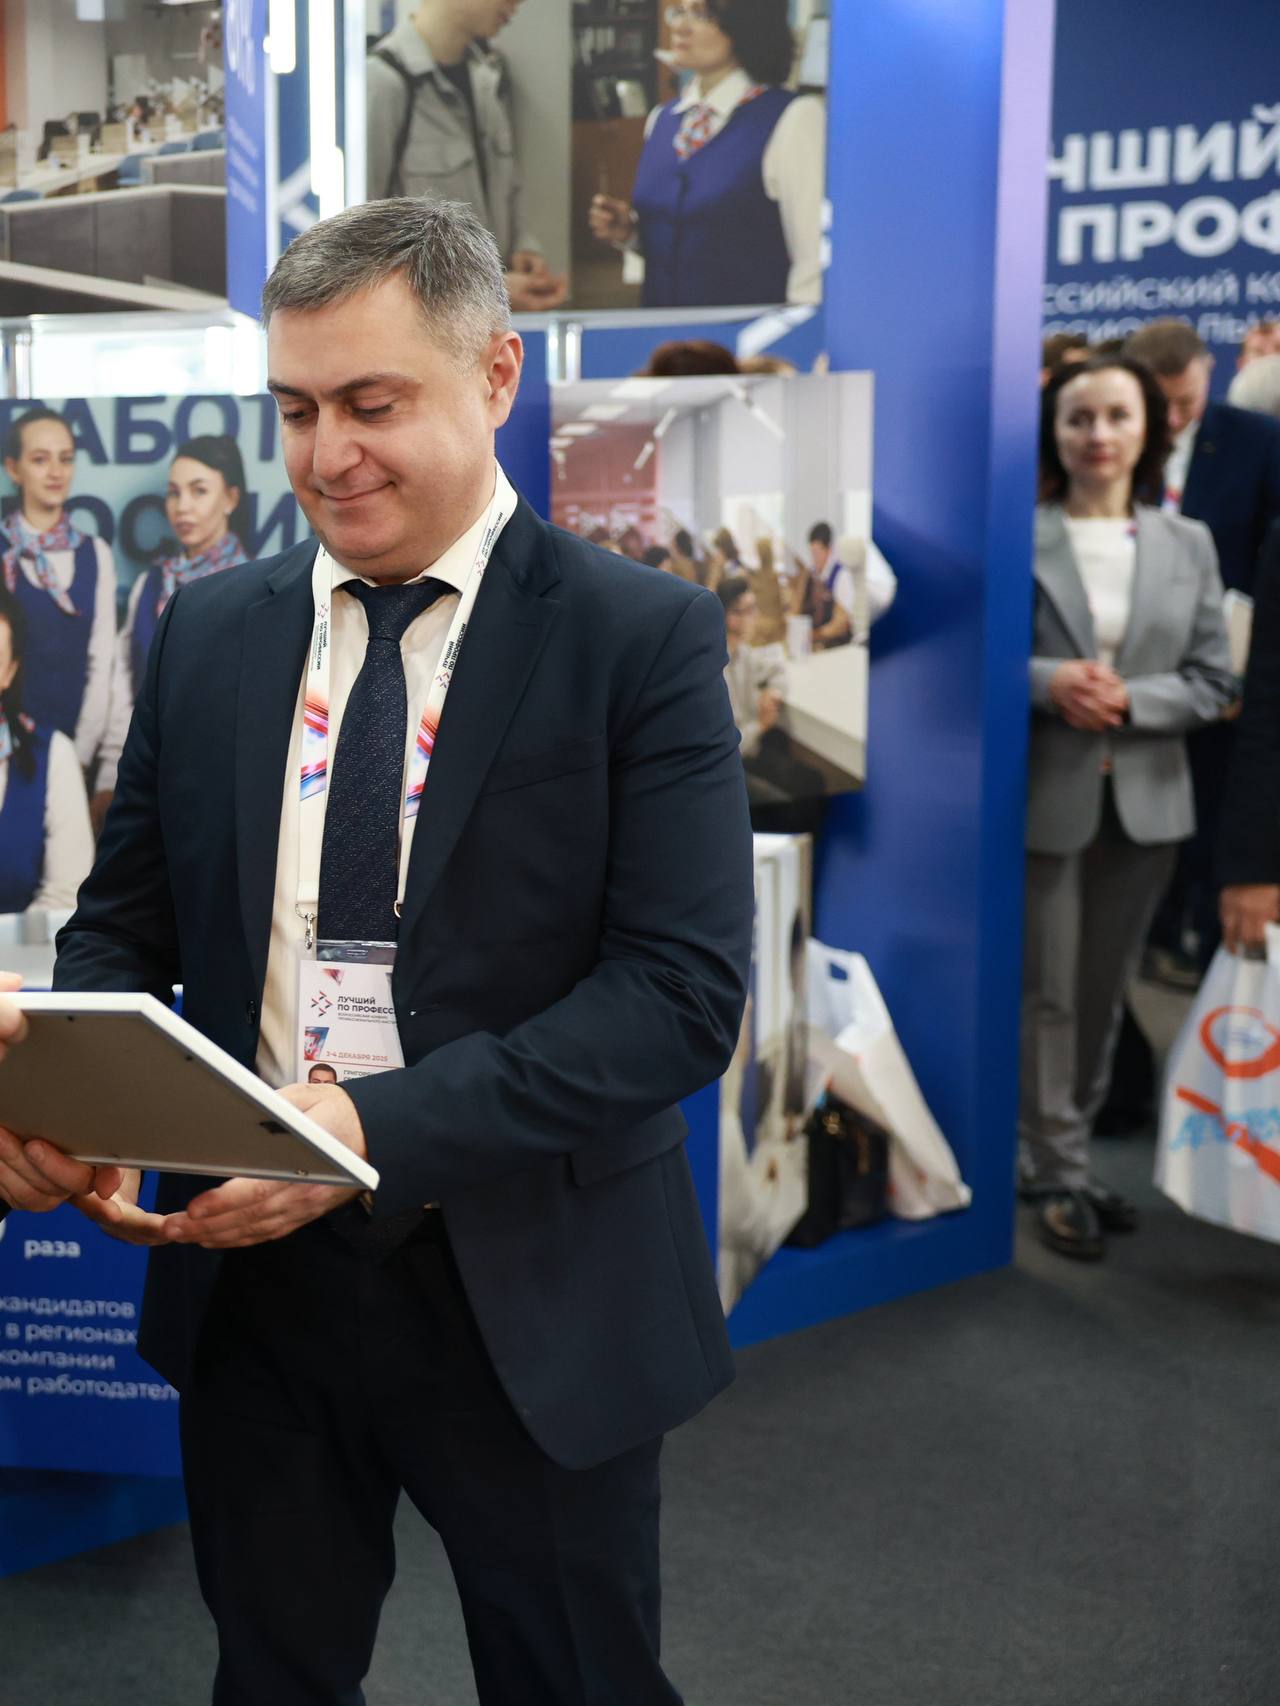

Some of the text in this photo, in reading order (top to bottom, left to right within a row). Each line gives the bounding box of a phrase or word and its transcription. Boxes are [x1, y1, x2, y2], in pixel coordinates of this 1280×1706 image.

[337, 996, 376, 1005] ЛУЧШИЙ
[24, 1240, 81, 1259] раза
[5, 1323, 20, 1339] в
